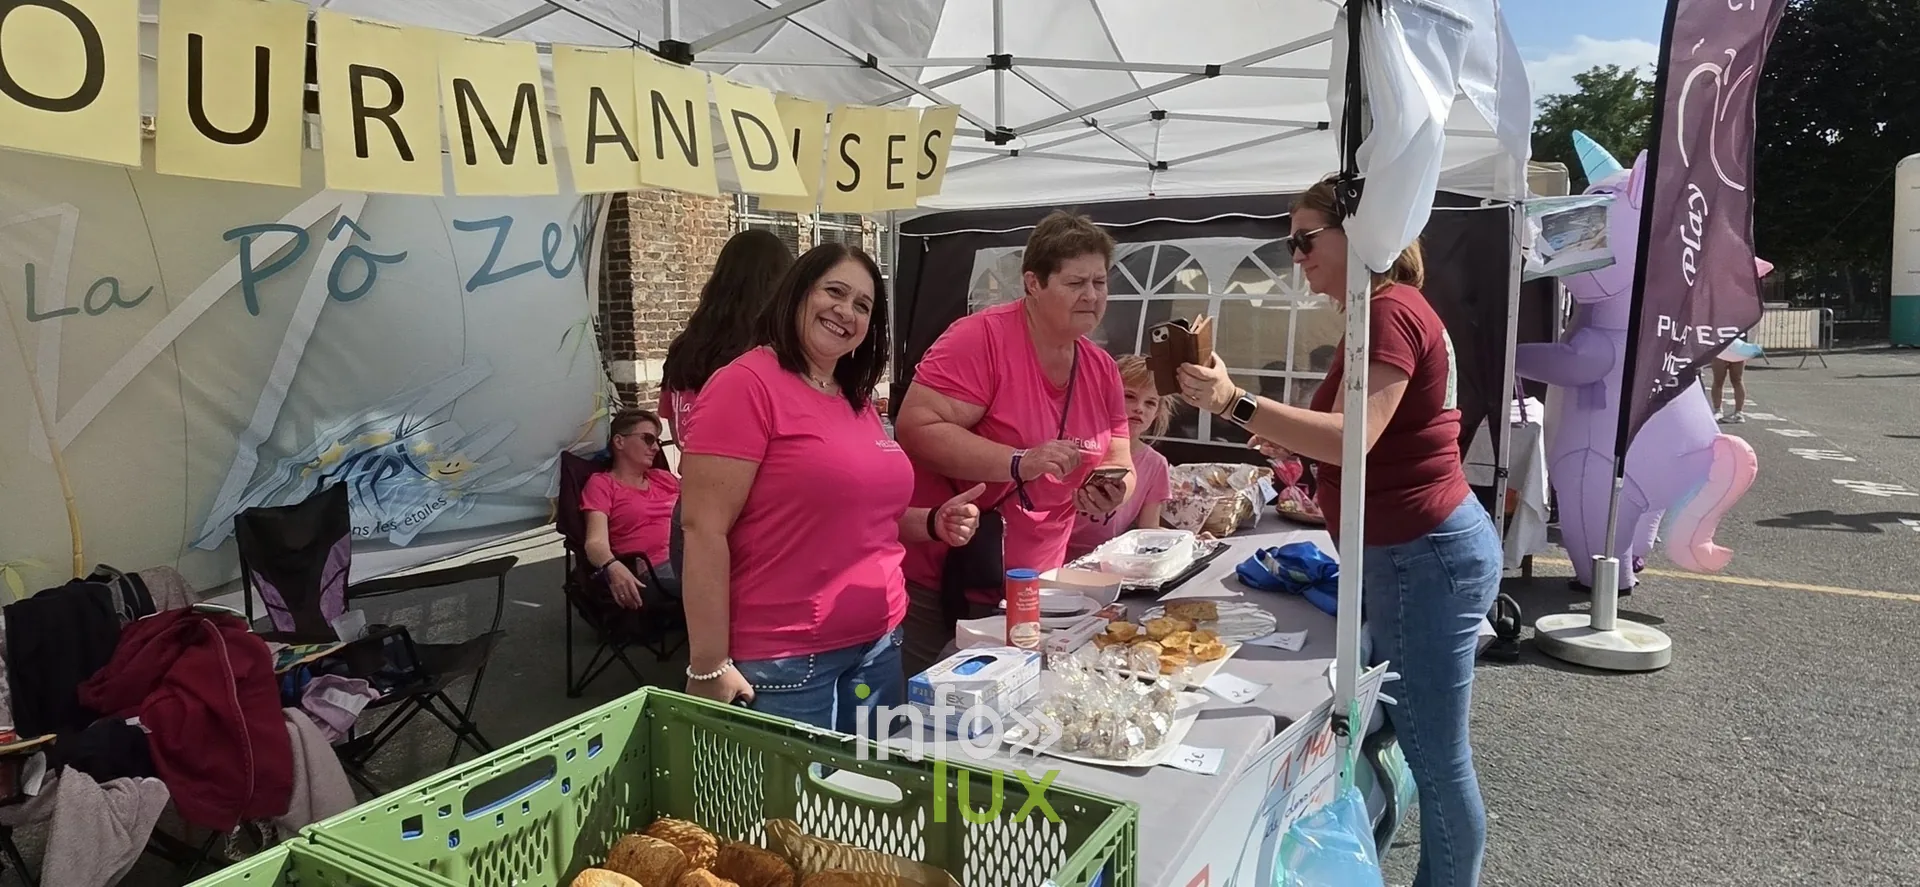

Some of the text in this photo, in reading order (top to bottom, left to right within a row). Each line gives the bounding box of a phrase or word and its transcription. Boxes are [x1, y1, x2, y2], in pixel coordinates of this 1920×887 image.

[25, 262, 154, 322] La
[222, 214, 408, 316] Pô
[351, 496, 448, 537] ns les étoiles
